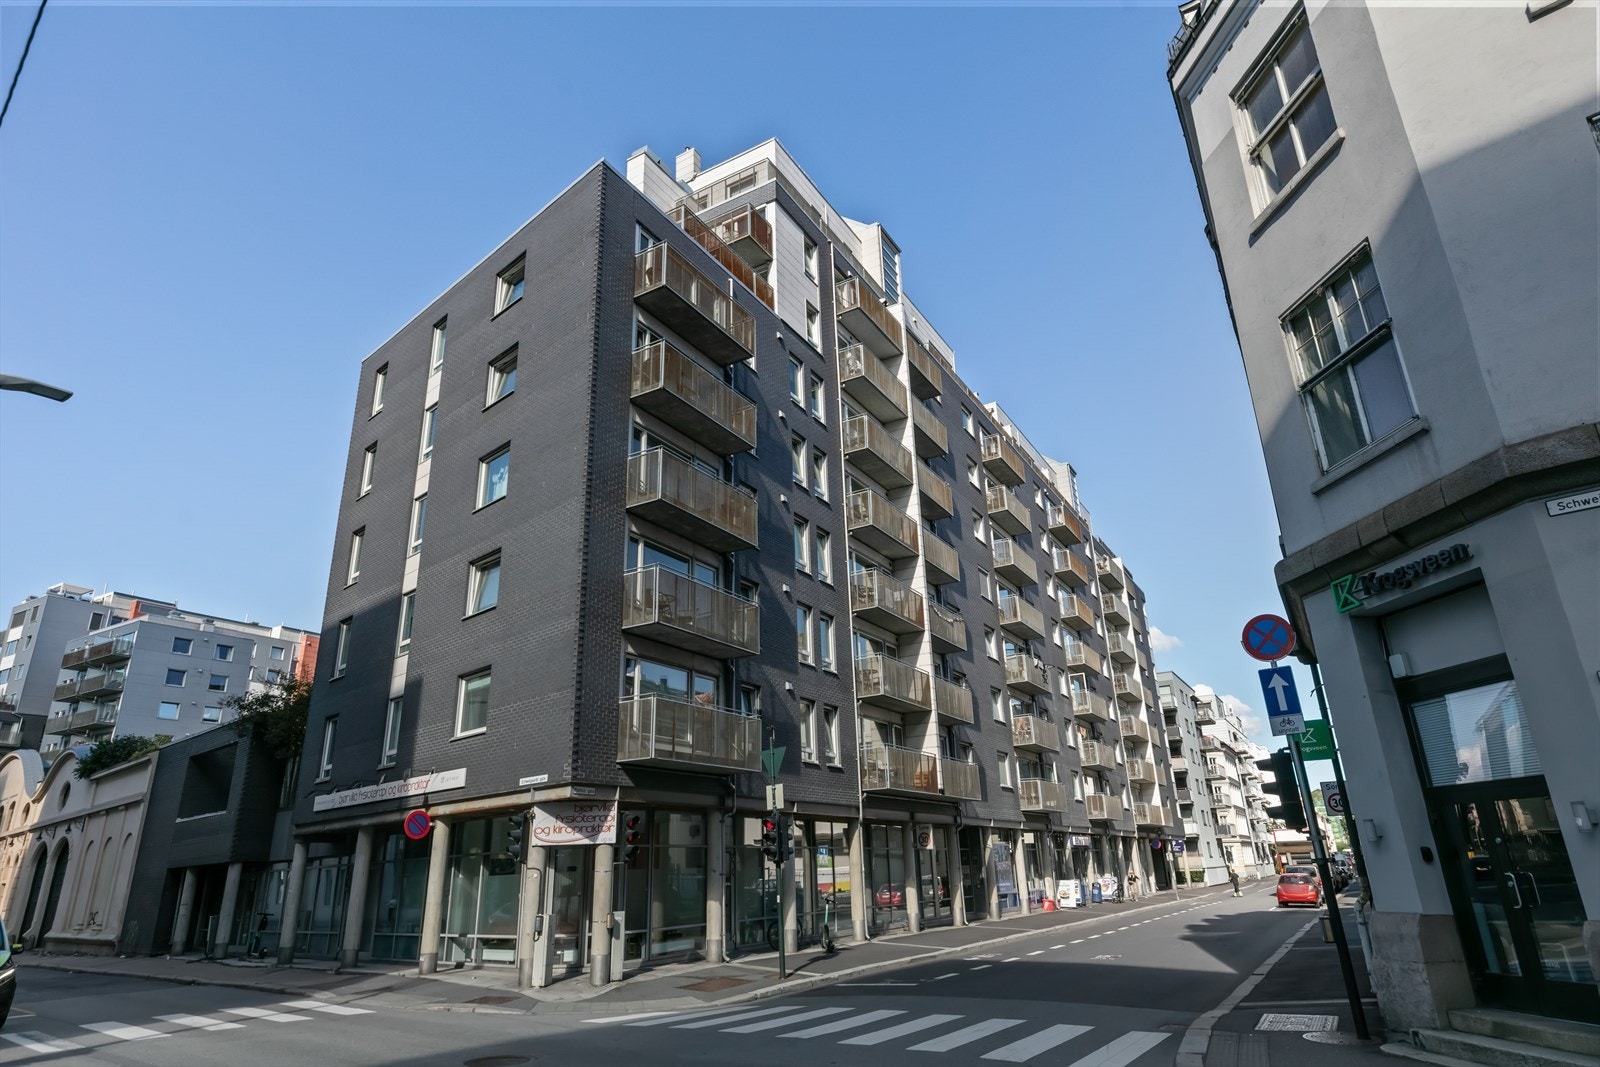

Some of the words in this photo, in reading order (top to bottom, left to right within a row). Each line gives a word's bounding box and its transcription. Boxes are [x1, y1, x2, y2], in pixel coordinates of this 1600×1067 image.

[1359, 544, 1473, 595] Krogsveen
[388, 785, 397, 797] og
[574, 803, 616, 815] bjørvika
[555, 814, 616, 823] fysioterapi
[534, 825, 551, 837] og
[552, 823, 615, 836] kiropraktor
